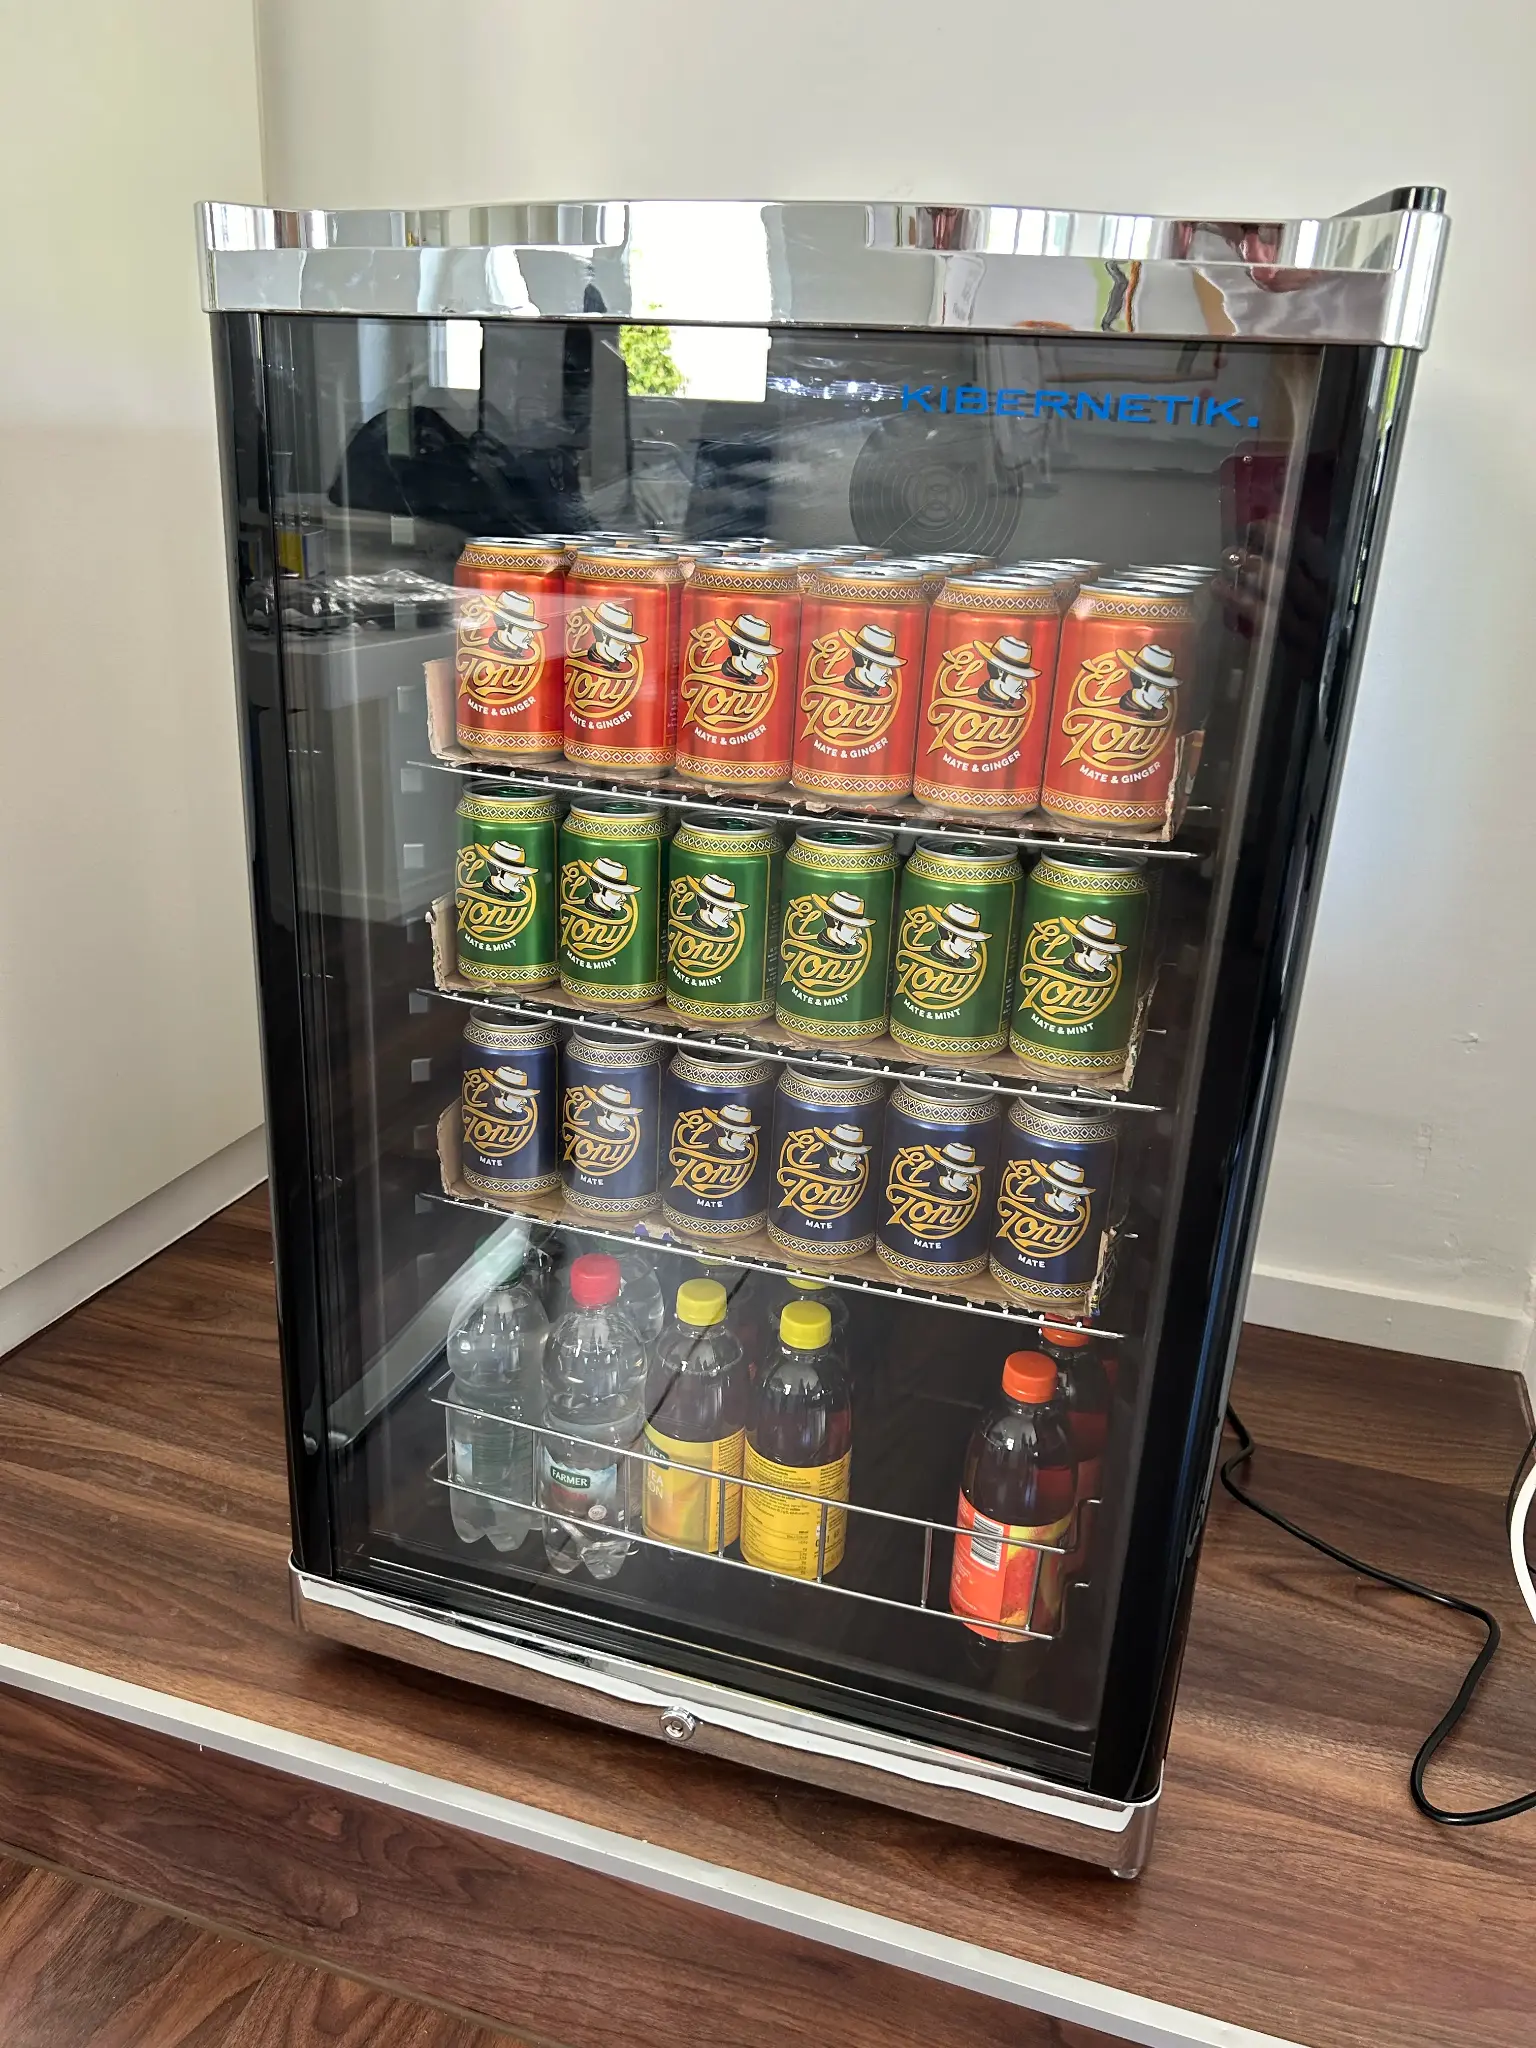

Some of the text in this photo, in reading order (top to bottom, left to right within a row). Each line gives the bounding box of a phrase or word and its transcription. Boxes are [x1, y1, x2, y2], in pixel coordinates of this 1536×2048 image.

[566, 609, 591, 658] El
[689, 628, 727, 674] El
[456, 645, 541, 700] Tony
[564, 654, 639, 710] Tony
[812, 638, 851, 686] El
[943, 650, 985, 699] El
[1078, 658, 1129, 708] El
[467, 695, 537, 716] MATE & GINGER
[569, 709, 633, 730] MATE & GINGER
[681, 668, 774, 729] Tony
[800, 682, 898, 743] Tony
[694, 723, 767, 746] MATE & GINGER
[926, 694, 1030, 757] Tony
[1060, 702, 1172, 768] Tony
[813, 736, 889, 759] MATE & GINGER
[942, 749, 1022, 773] MATE & GINGER
[1079, 761, 1162, 784] MATE & GINGER
[457, 848, 485, 889] El
[561, 864, 587, 905] El
[456, 884, 531, 934] Tony
[670, 879, 696, 921] El
[789, 898, 822, 941] El
[464, 933, 518, 952] MATE & MINT
[560, 901, 632, 951] Tony
[668, 919, 739, 968] Tony
[904, 909, 936, 952] El
[1030, 921, 1069, 965] El
[566, 949, 618, 970] MATE & MINT
[672, 965, 723, 988] MATE & MINT
[780, 936, 867, 989] Tony
[894, 950, 982, 1001] Tony
[791, 986, 849, 1007] MATE & MINT
[903, 999, 962, 1020] MATE & MINT
[1018, 963, 1118, 1015] Tony
[1031, 1013, 1095, 1035] MATE & MINT
[463, 1070, 490, 1107] El
[566, 1087, 592, 1126] El
[462, 1105, 533, 1149] Tony
[563, 1123, 635, 1168] Tony
[678, 1111, 712, 1149] El
[479, 1155, 503, 1167] MATE
[669, 1143, 754, 1191] Tony
[787, 1131, 825, 1169] El
[896, 1147, 935, 1188] El
[580, 1174, 604, 1186] MATE
[777, 1163, 865, 1211] Tony
[1006, 1159, 1041, 1203] El
[697, 1198, 724, 1208] MATE
[886, 1183, 977, 1232] Tony
[995, 1196, 1085, 1251] Tony
[805, 1219, 833, 1230] MATE
[913, 1238, 942, 1250] MATE
[1018, 1253, 1046, 1269] MATE
[552, 1469, 588, 1487] FARMER
